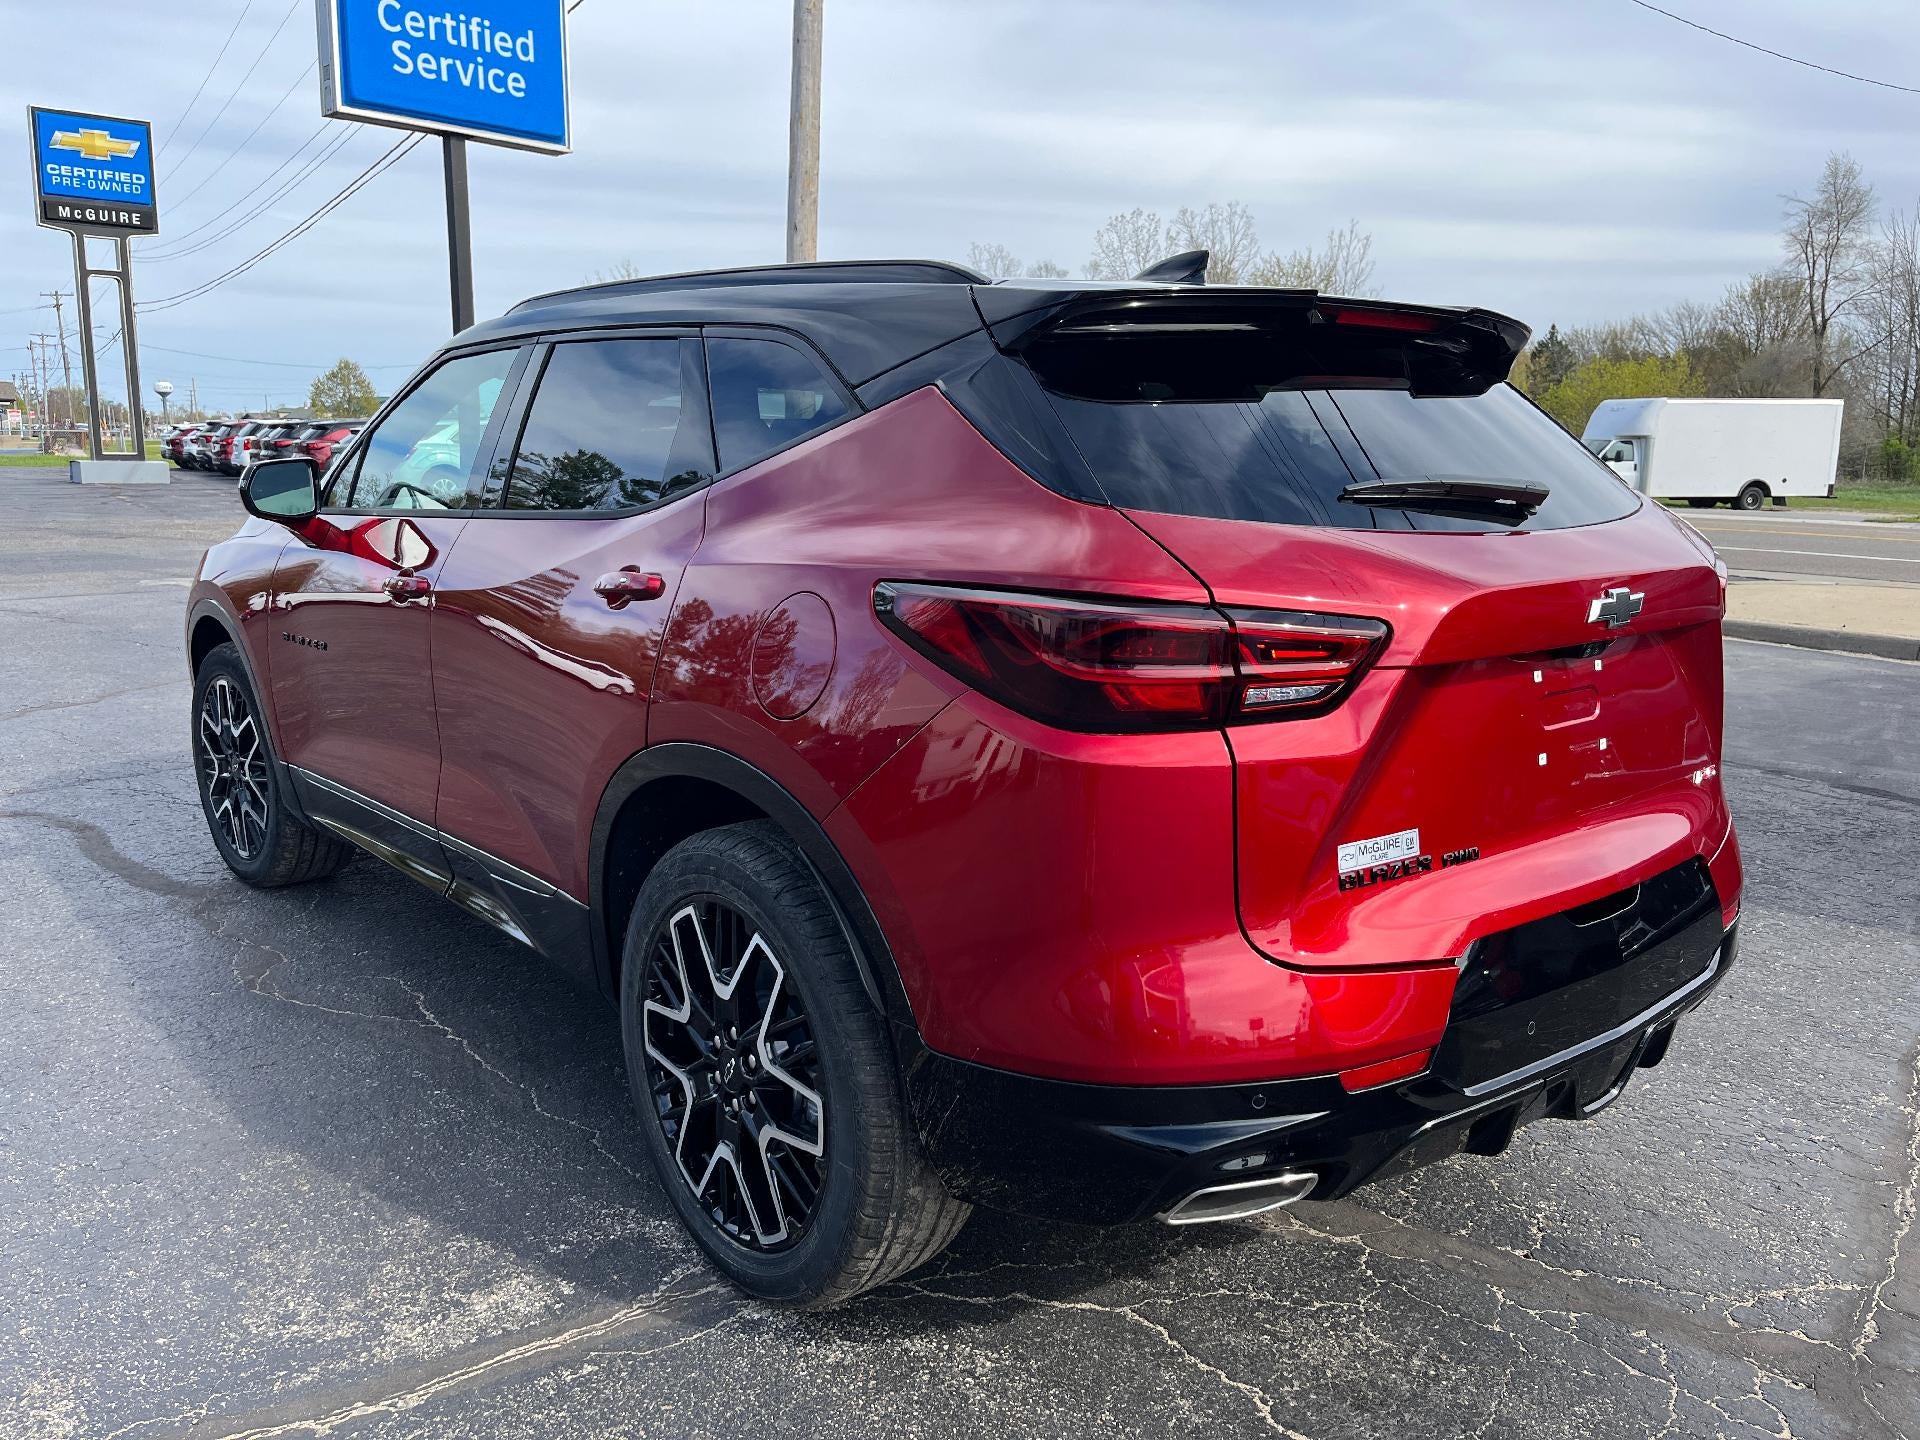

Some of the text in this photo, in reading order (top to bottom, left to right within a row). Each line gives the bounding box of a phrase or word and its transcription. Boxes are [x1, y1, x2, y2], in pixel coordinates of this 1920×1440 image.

[377, 0, 535, 62] Certified
[391, 39, 527, 98] Service
[46, 163, 146, 184] CERTIFIED
[52, 175, 141, 194] PRE-OWNED
[58, 206, 141, 225] McGUIRE
[1358, 837, 1401, 856] McGUIRE
[1338, 854, 1432, 891] BLAZER
